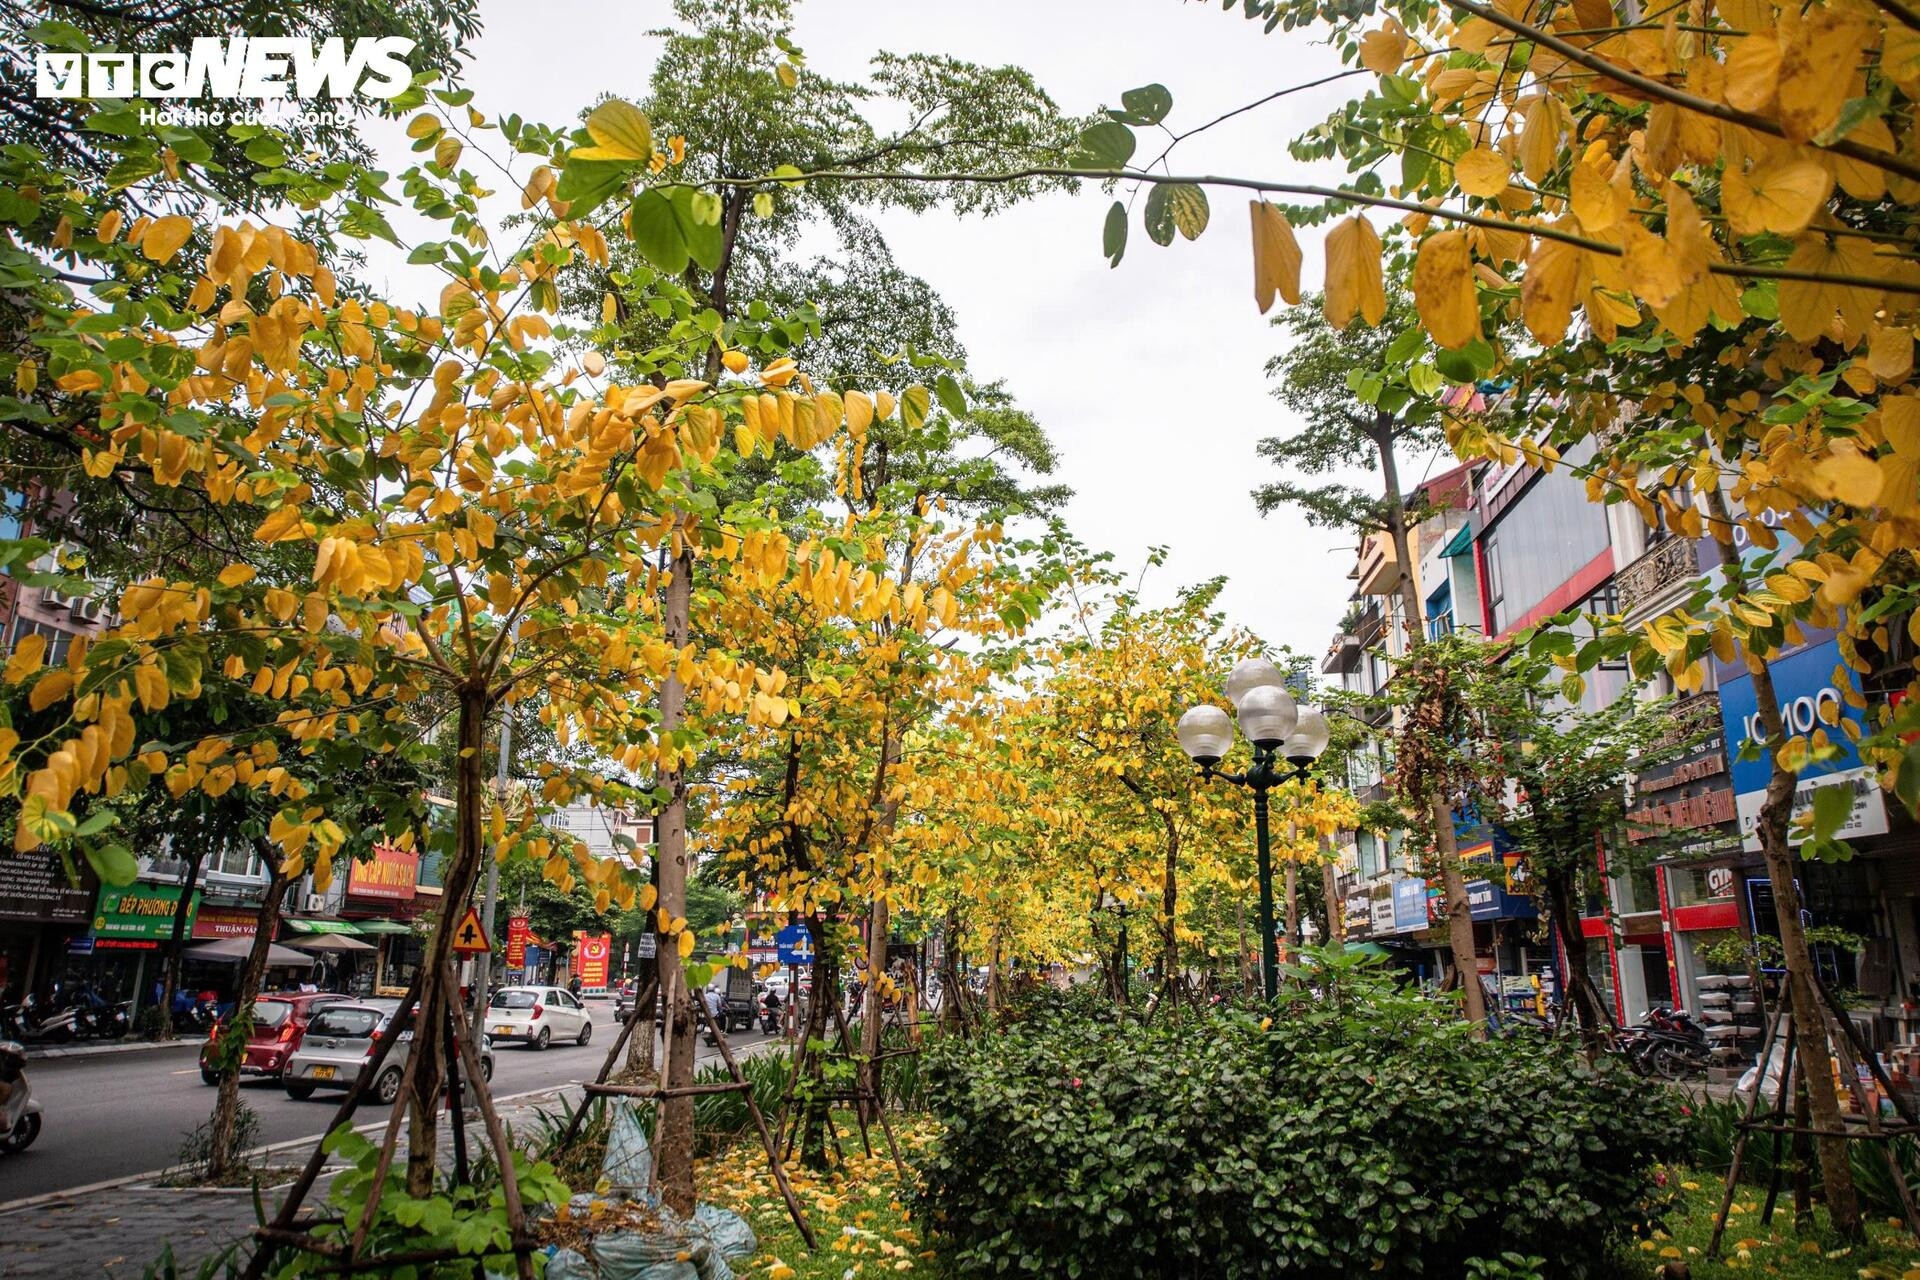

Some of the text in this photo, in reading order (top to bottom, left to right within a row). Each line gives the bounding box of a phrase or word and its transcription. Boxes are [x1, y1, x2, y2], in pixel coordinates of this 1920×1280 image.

[119, 893, 137, 914] BẾP
[136, 897, 170, 917] PHƯƠNG
[215, 924, 242, 935] THUẬN
